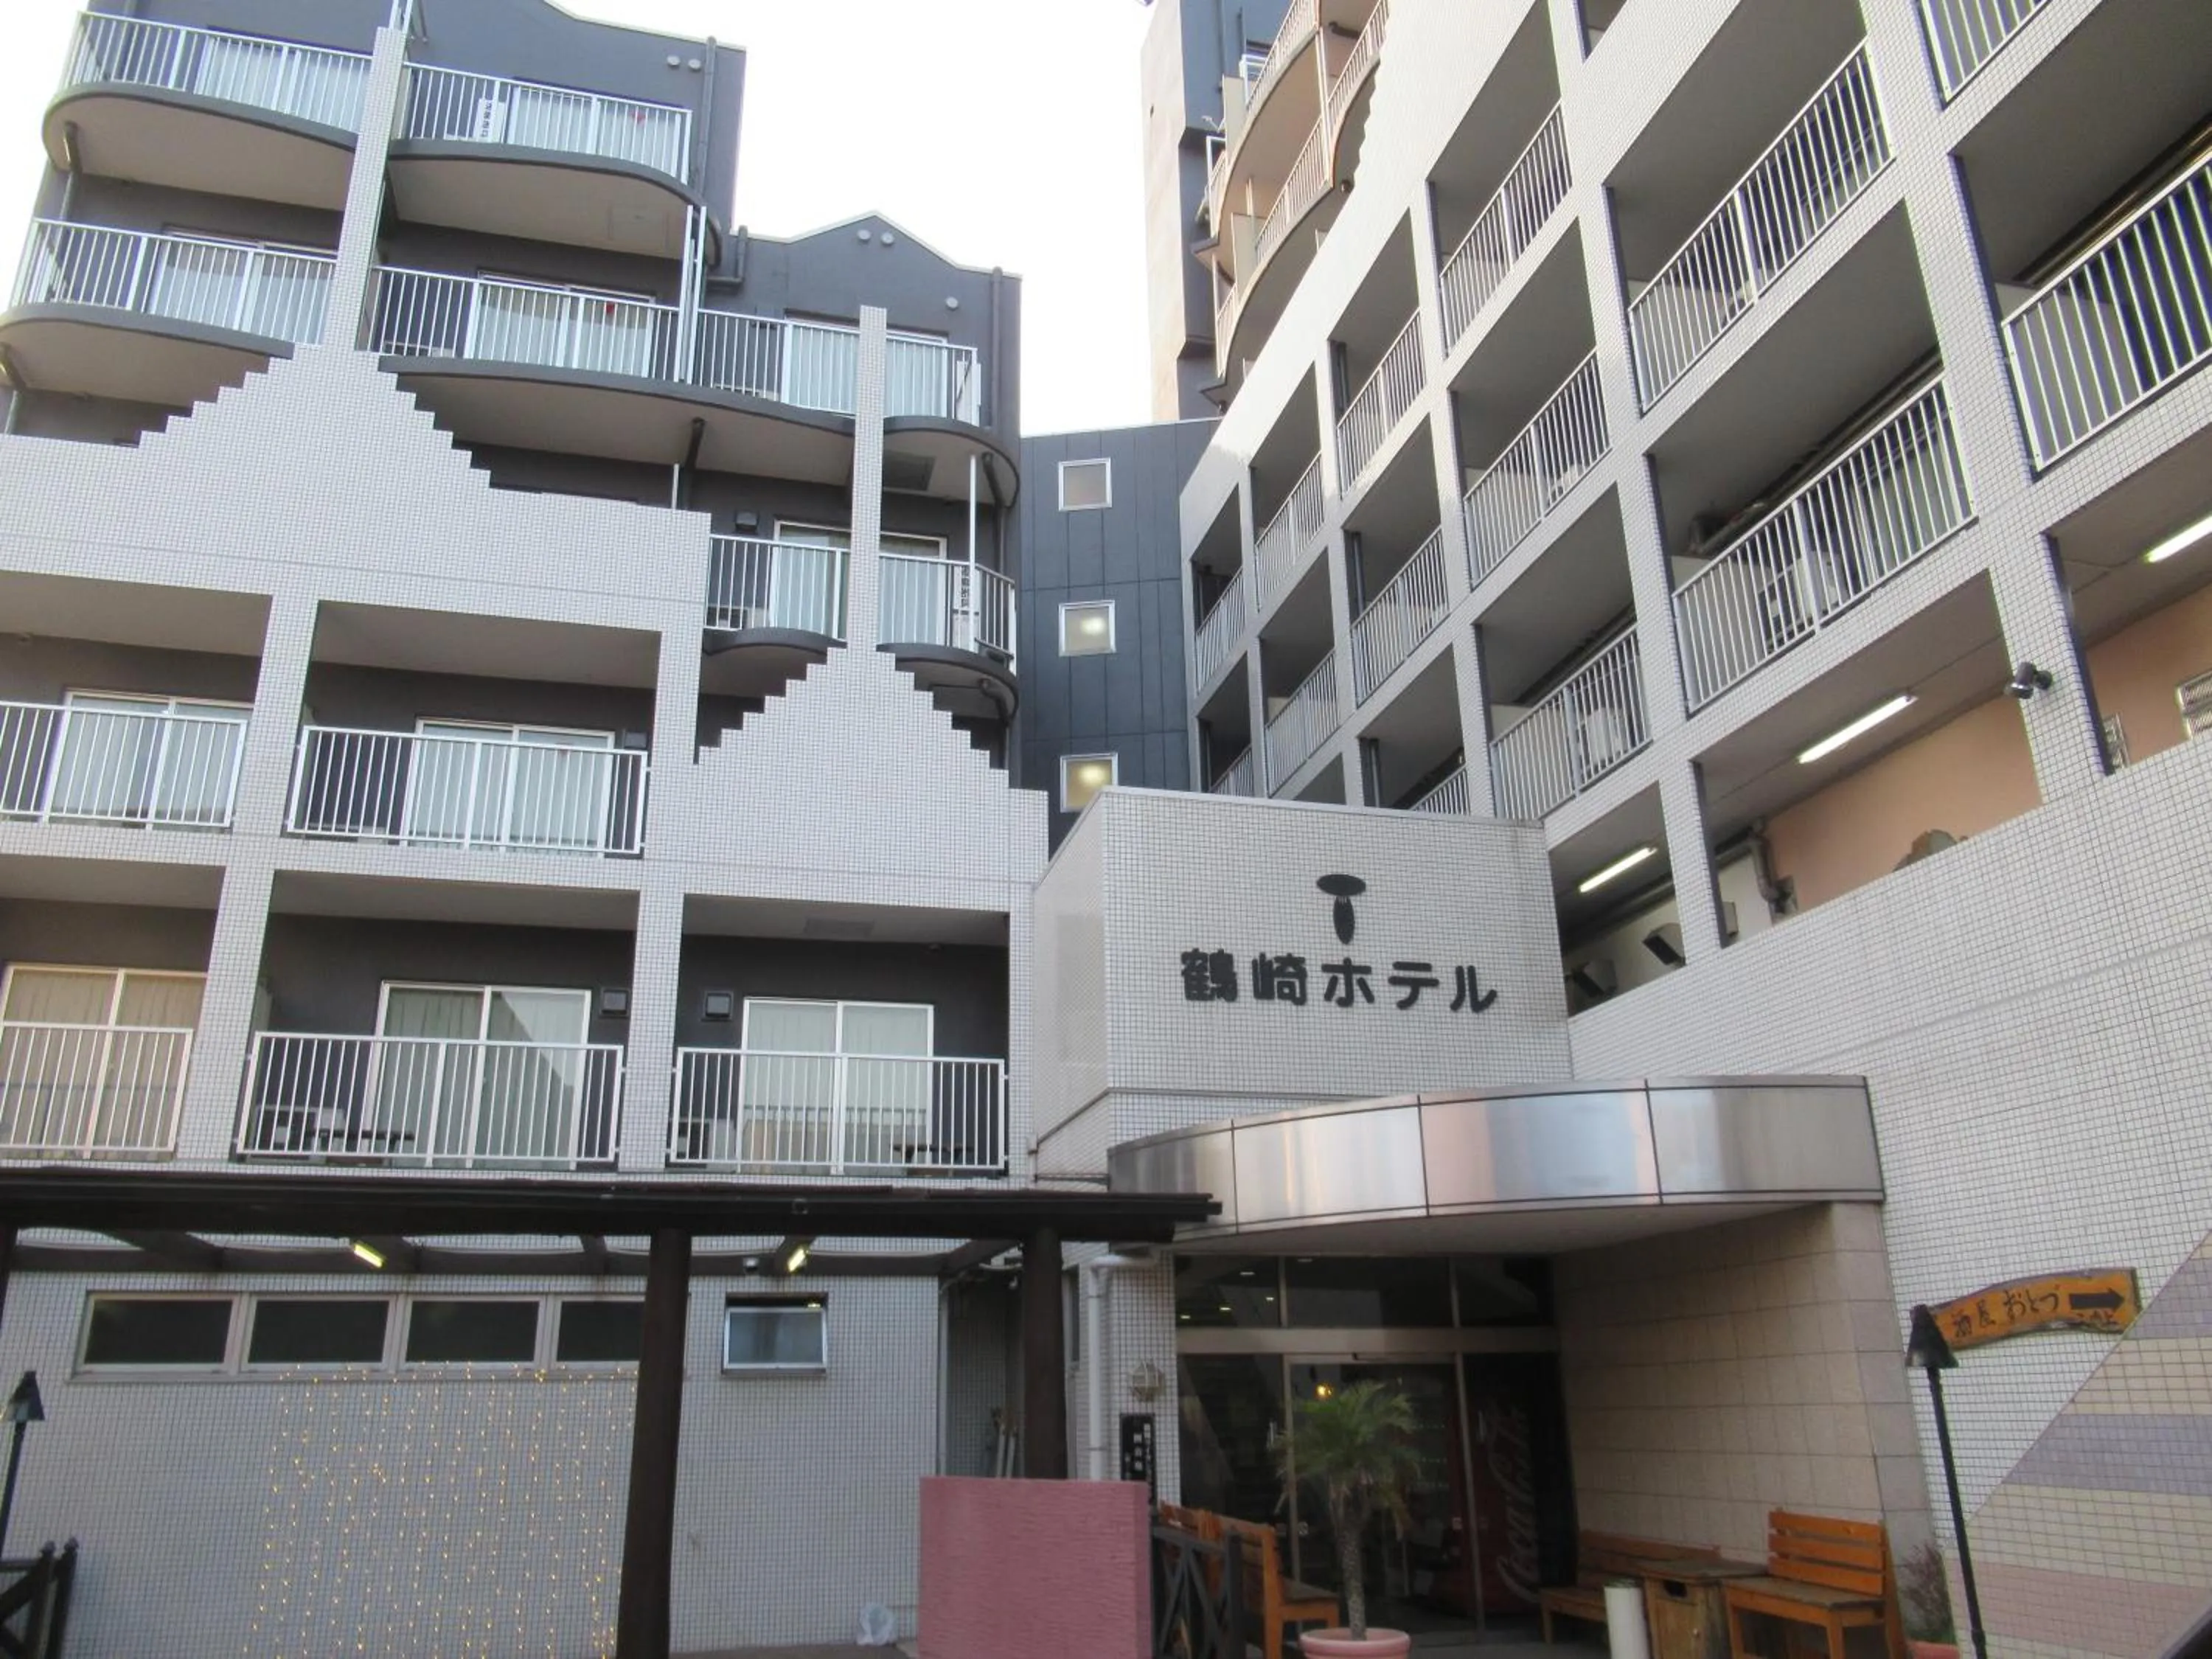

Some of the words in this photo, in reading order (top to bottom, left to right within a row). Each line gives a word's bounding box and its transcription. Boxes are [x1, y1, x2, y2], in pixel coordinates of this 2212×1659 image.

[1180, 947, 1498, 1014] 鶴崎ホテル
